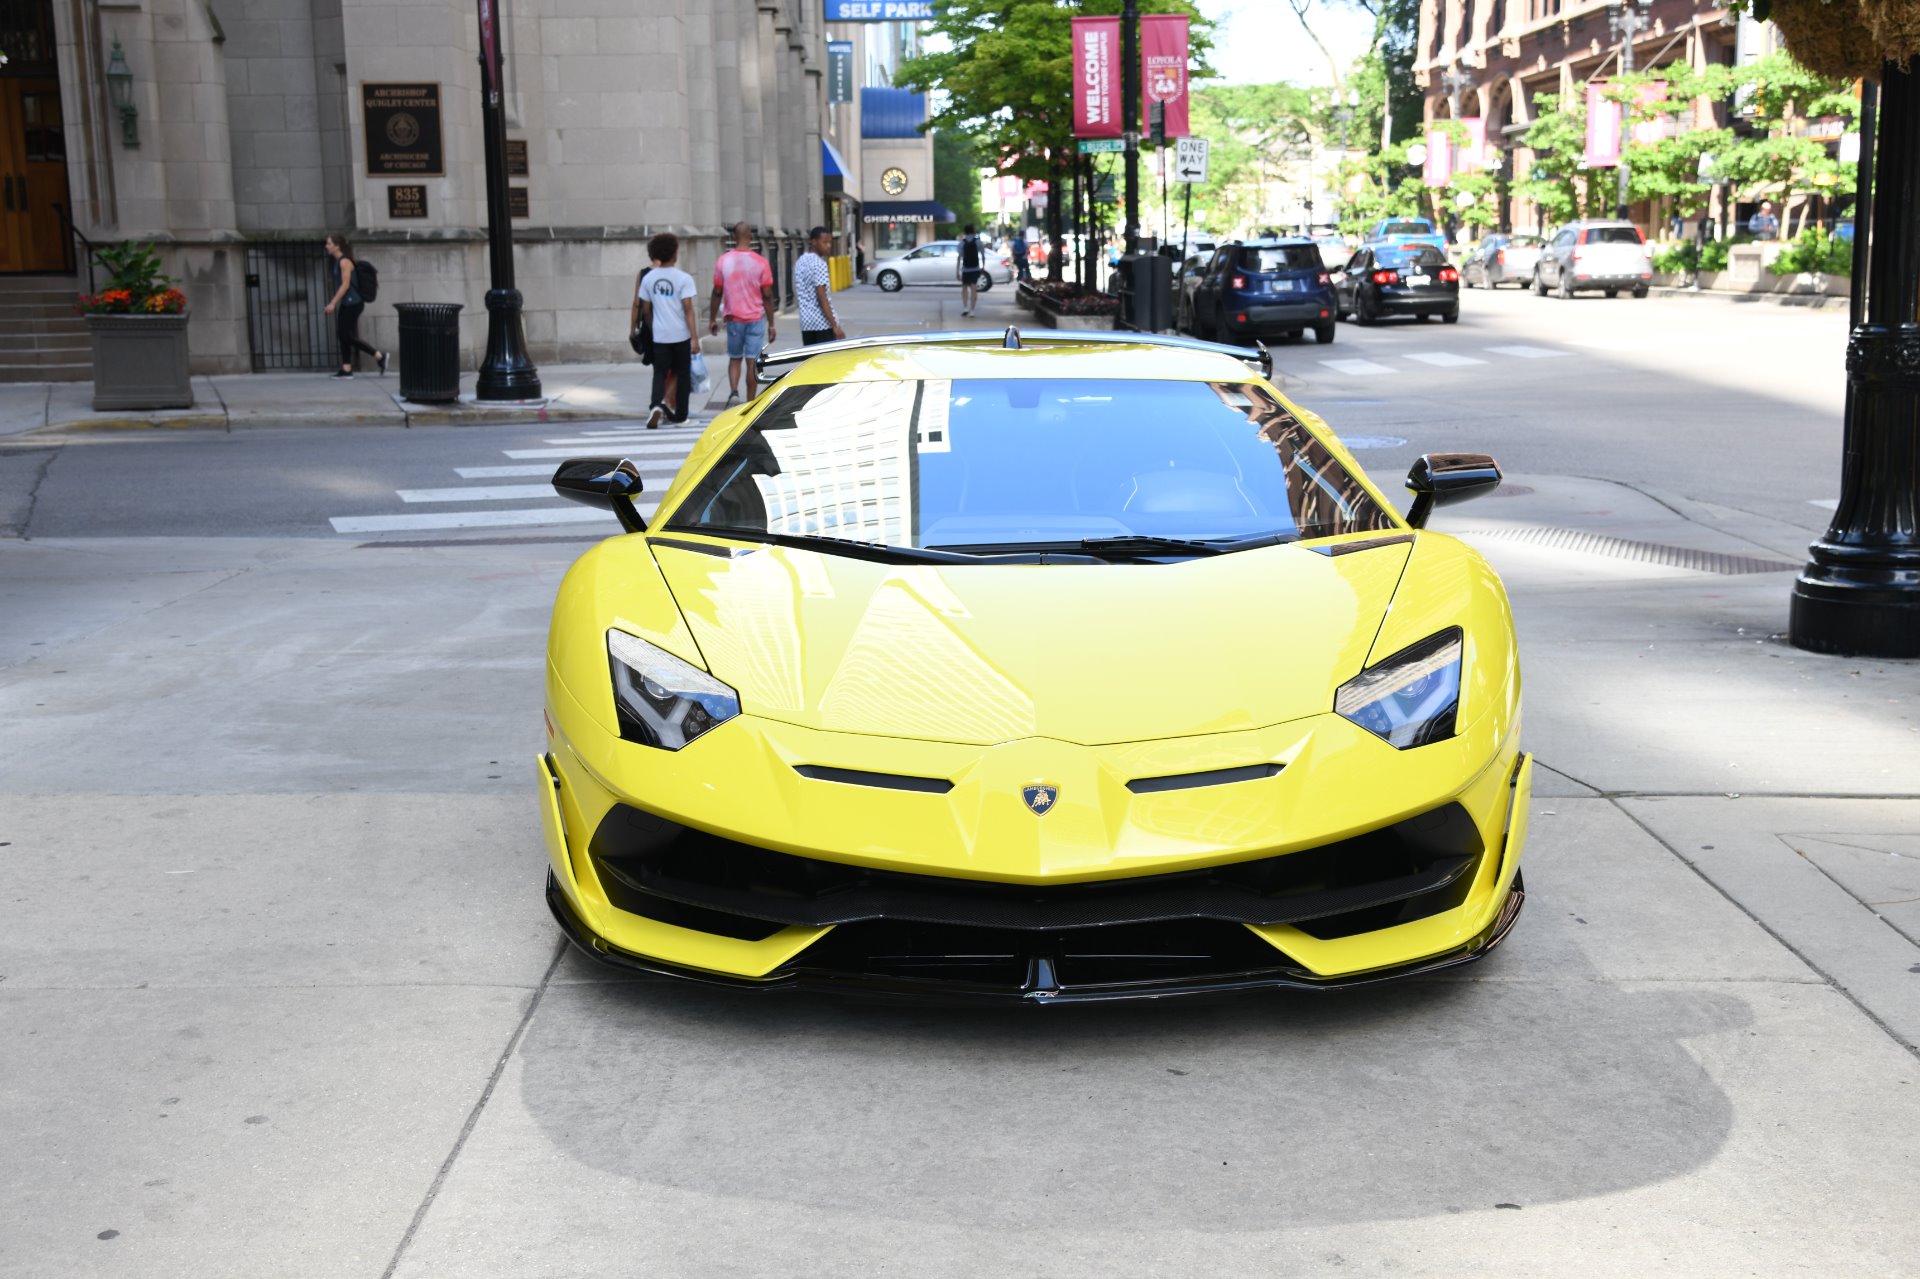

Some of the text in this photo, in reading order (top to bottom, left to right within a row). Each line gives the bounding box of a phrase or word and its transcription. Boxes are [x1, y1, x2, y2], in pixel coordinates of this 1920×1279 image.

[839, 2, 933, 17] SELF PARK
[1147, 56, 1183, 65] LOYOLA
[1084, 31, 1100, 125] WELCOME
[1100, 31, 1110, 125] WATER TOWER CAMPUS
[374, 88, 428, 97] ARCHBISHOP
[366, 98, 436, 108] QUIGLEY CENTER
[1180, 140, 1205, 152] ONE
[1179, 154, 1204, 165] WAY
[395, 187, 420, 201] 835
[864, 214, 934, 223] GHIRARDELLI
